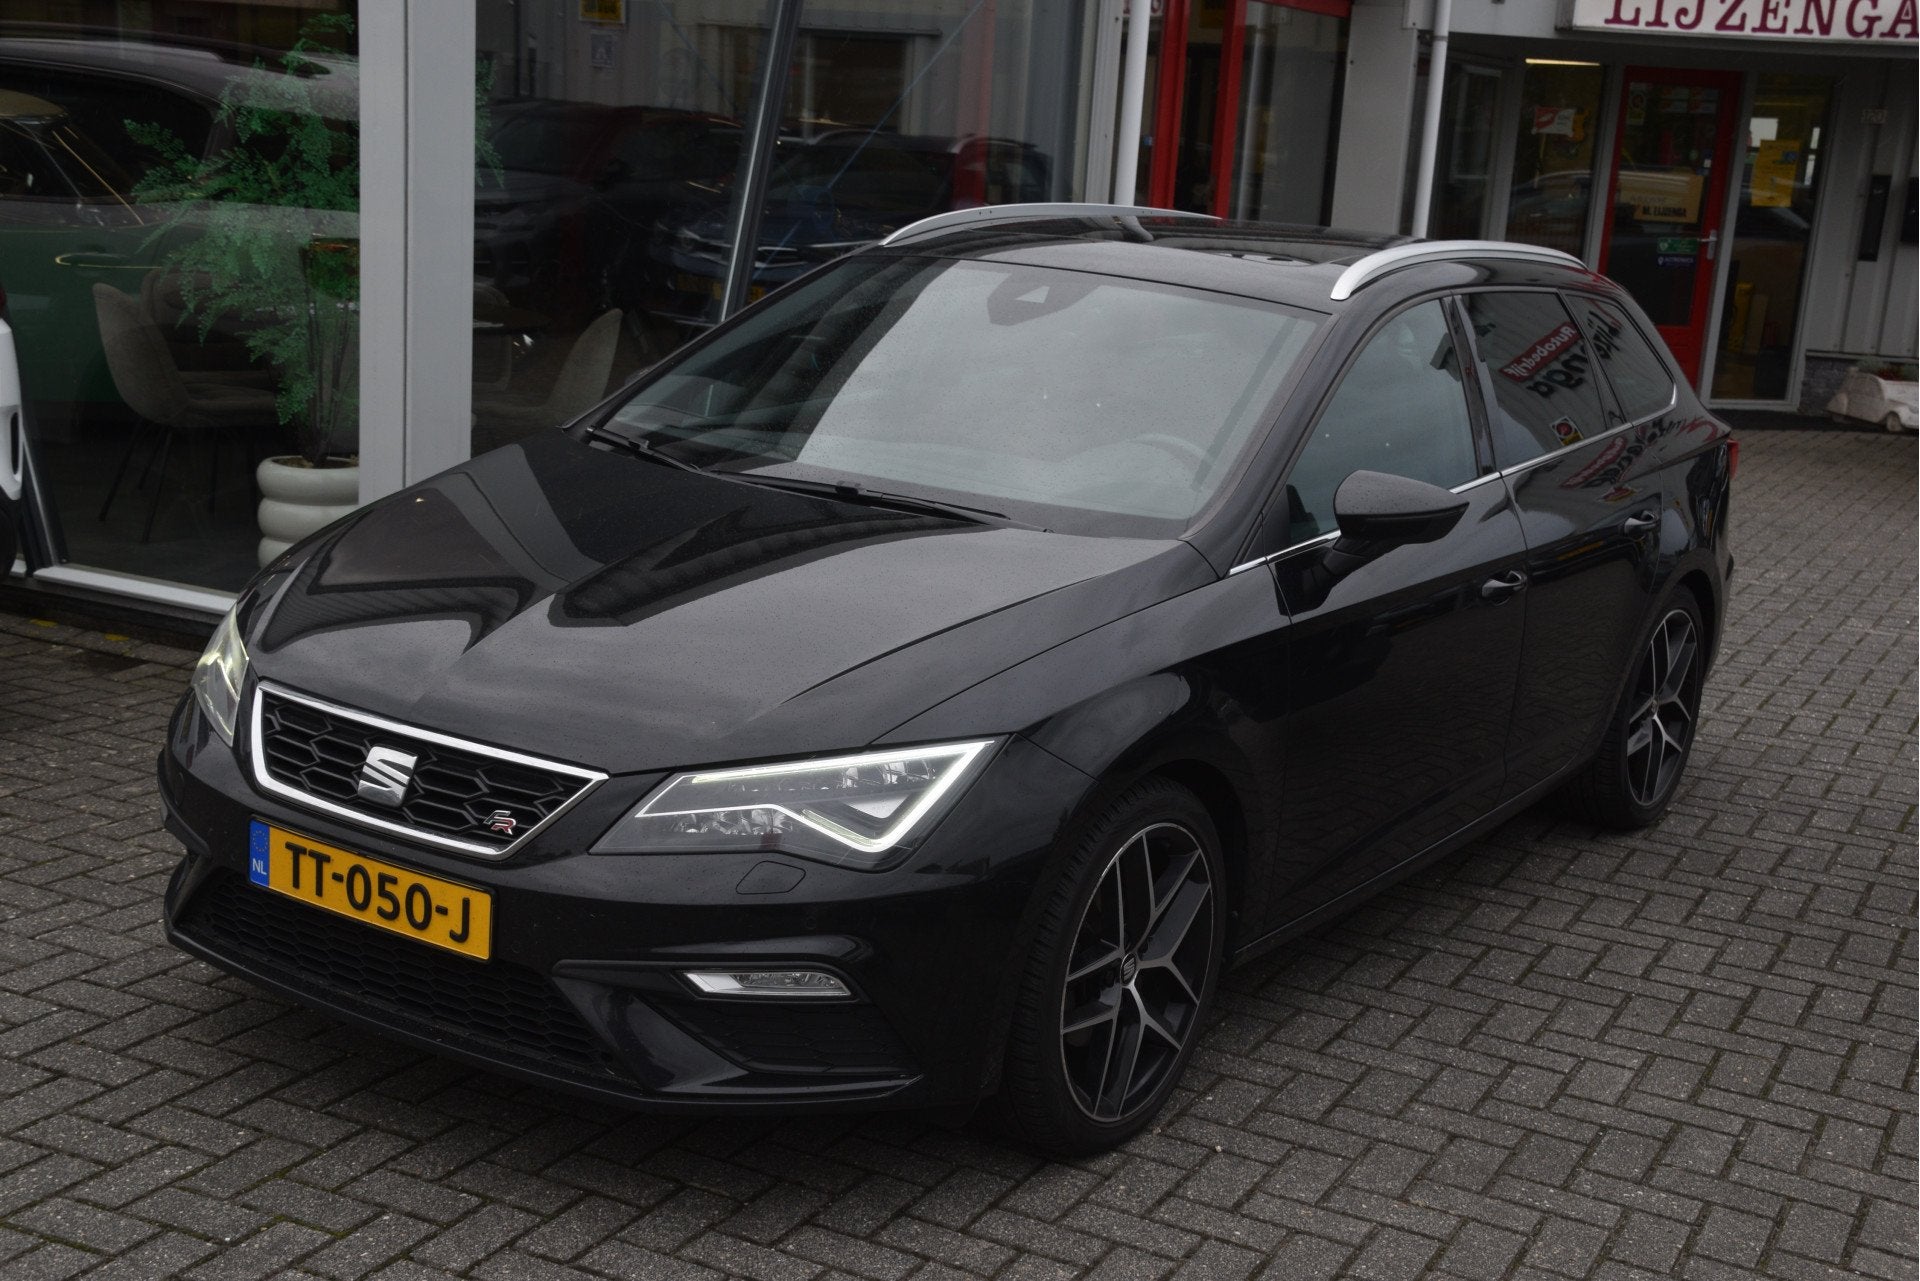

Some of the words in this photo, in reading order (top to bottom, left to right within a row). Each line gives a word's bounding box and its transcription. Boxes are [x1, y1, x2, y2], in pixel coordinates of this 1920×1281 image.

[1604, 0, 1918, 38] LIJZENGA
[483, 809, 516, 836] FR
[252, 857, 268, 876] NL
[285, 841, 471, 944] TT-050-J
